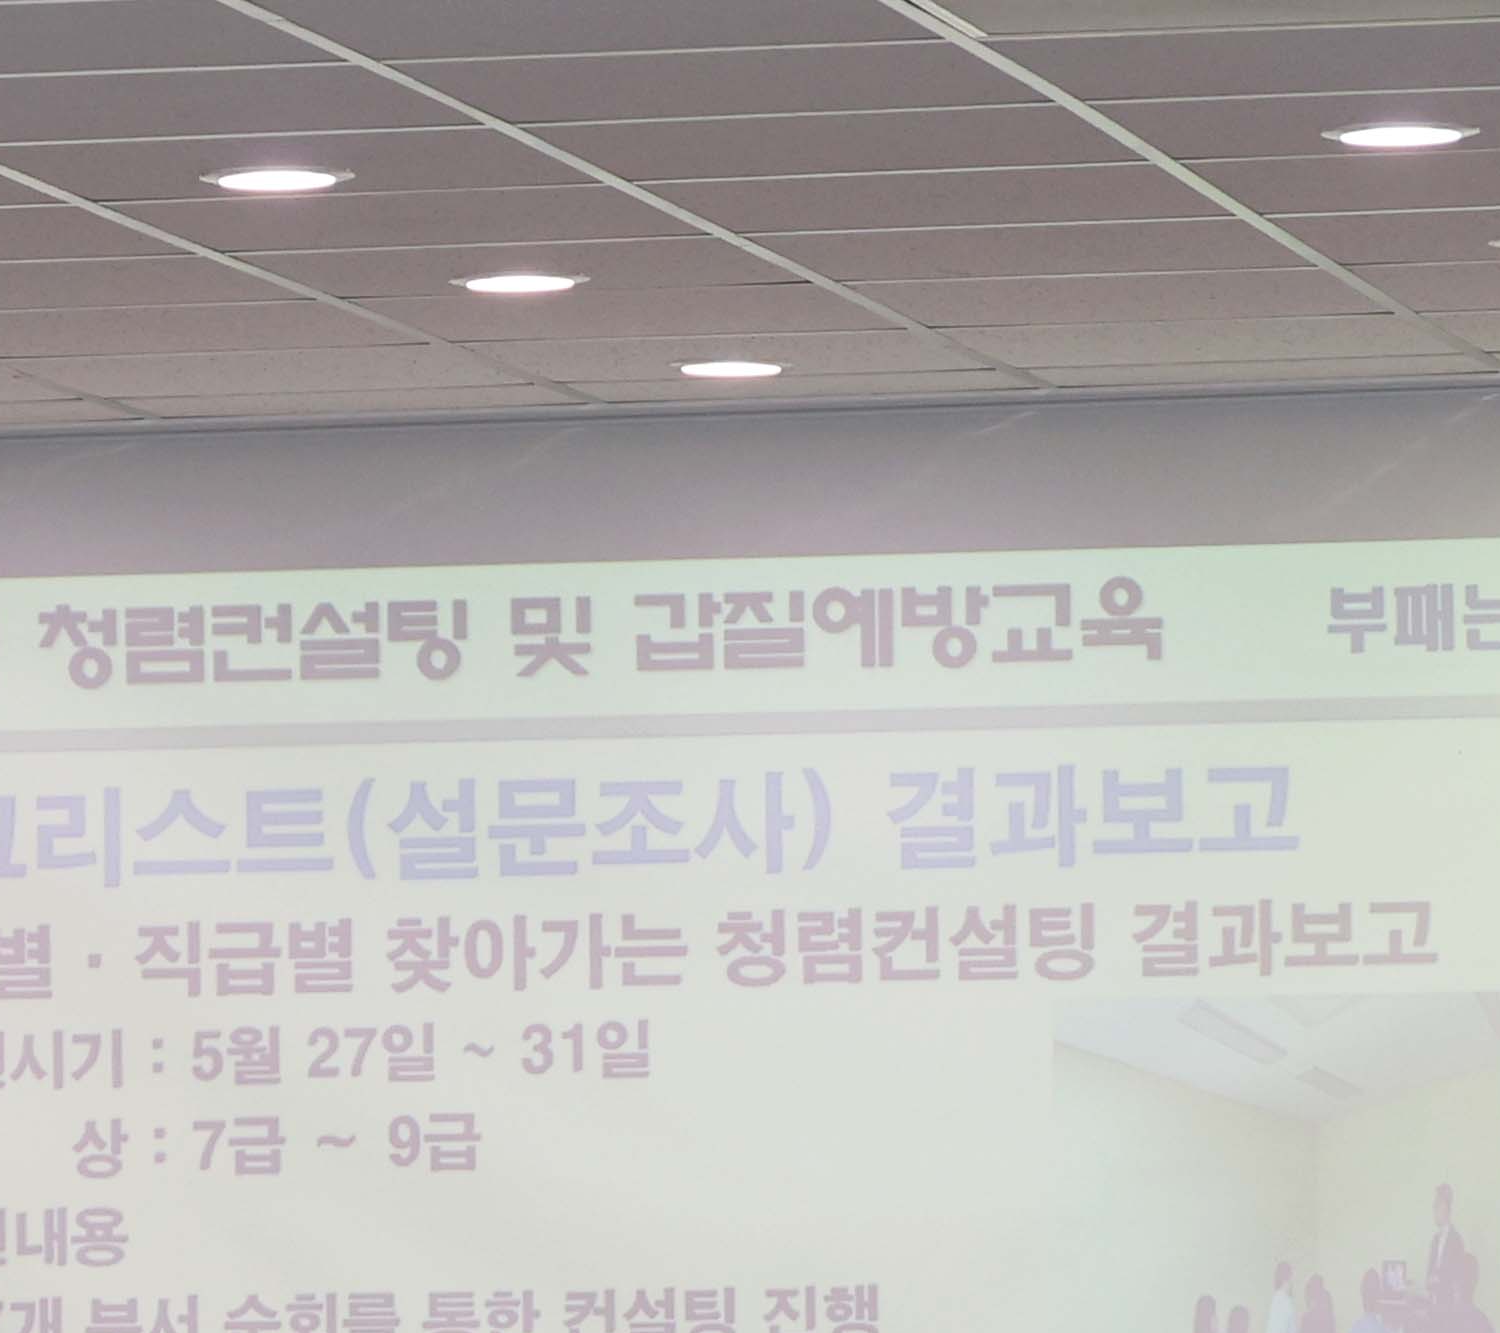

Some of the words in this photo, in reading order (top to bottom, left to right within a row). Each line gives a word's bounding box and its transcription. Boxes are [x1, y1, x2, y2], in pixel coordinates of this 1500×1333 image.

[37, 598, 470, 690] 청렴컨설팅
[509, 595, 593, 678] 및
[632, 574, 1165, 673] 갑질예방교육
[886, 763, 1301, 870] 결과보고
[133, 917, 354, 999] 직급별
[385, 911, 690, 994] 찾아가는
[715, 901, 1096, 989] 청렴컨설팅
[1131, 897, 1439, 978] 결과보고
[191, 1024, 282, 1087] 5월
[306, 1021, 436, 1083] 27일
[520, 1018, 651, 1080] 31일
[71, 1117, 131, 1180] 상
[192, 1115, 288, 1177] 7급
[387, 1112, 483, 1174] 9급
